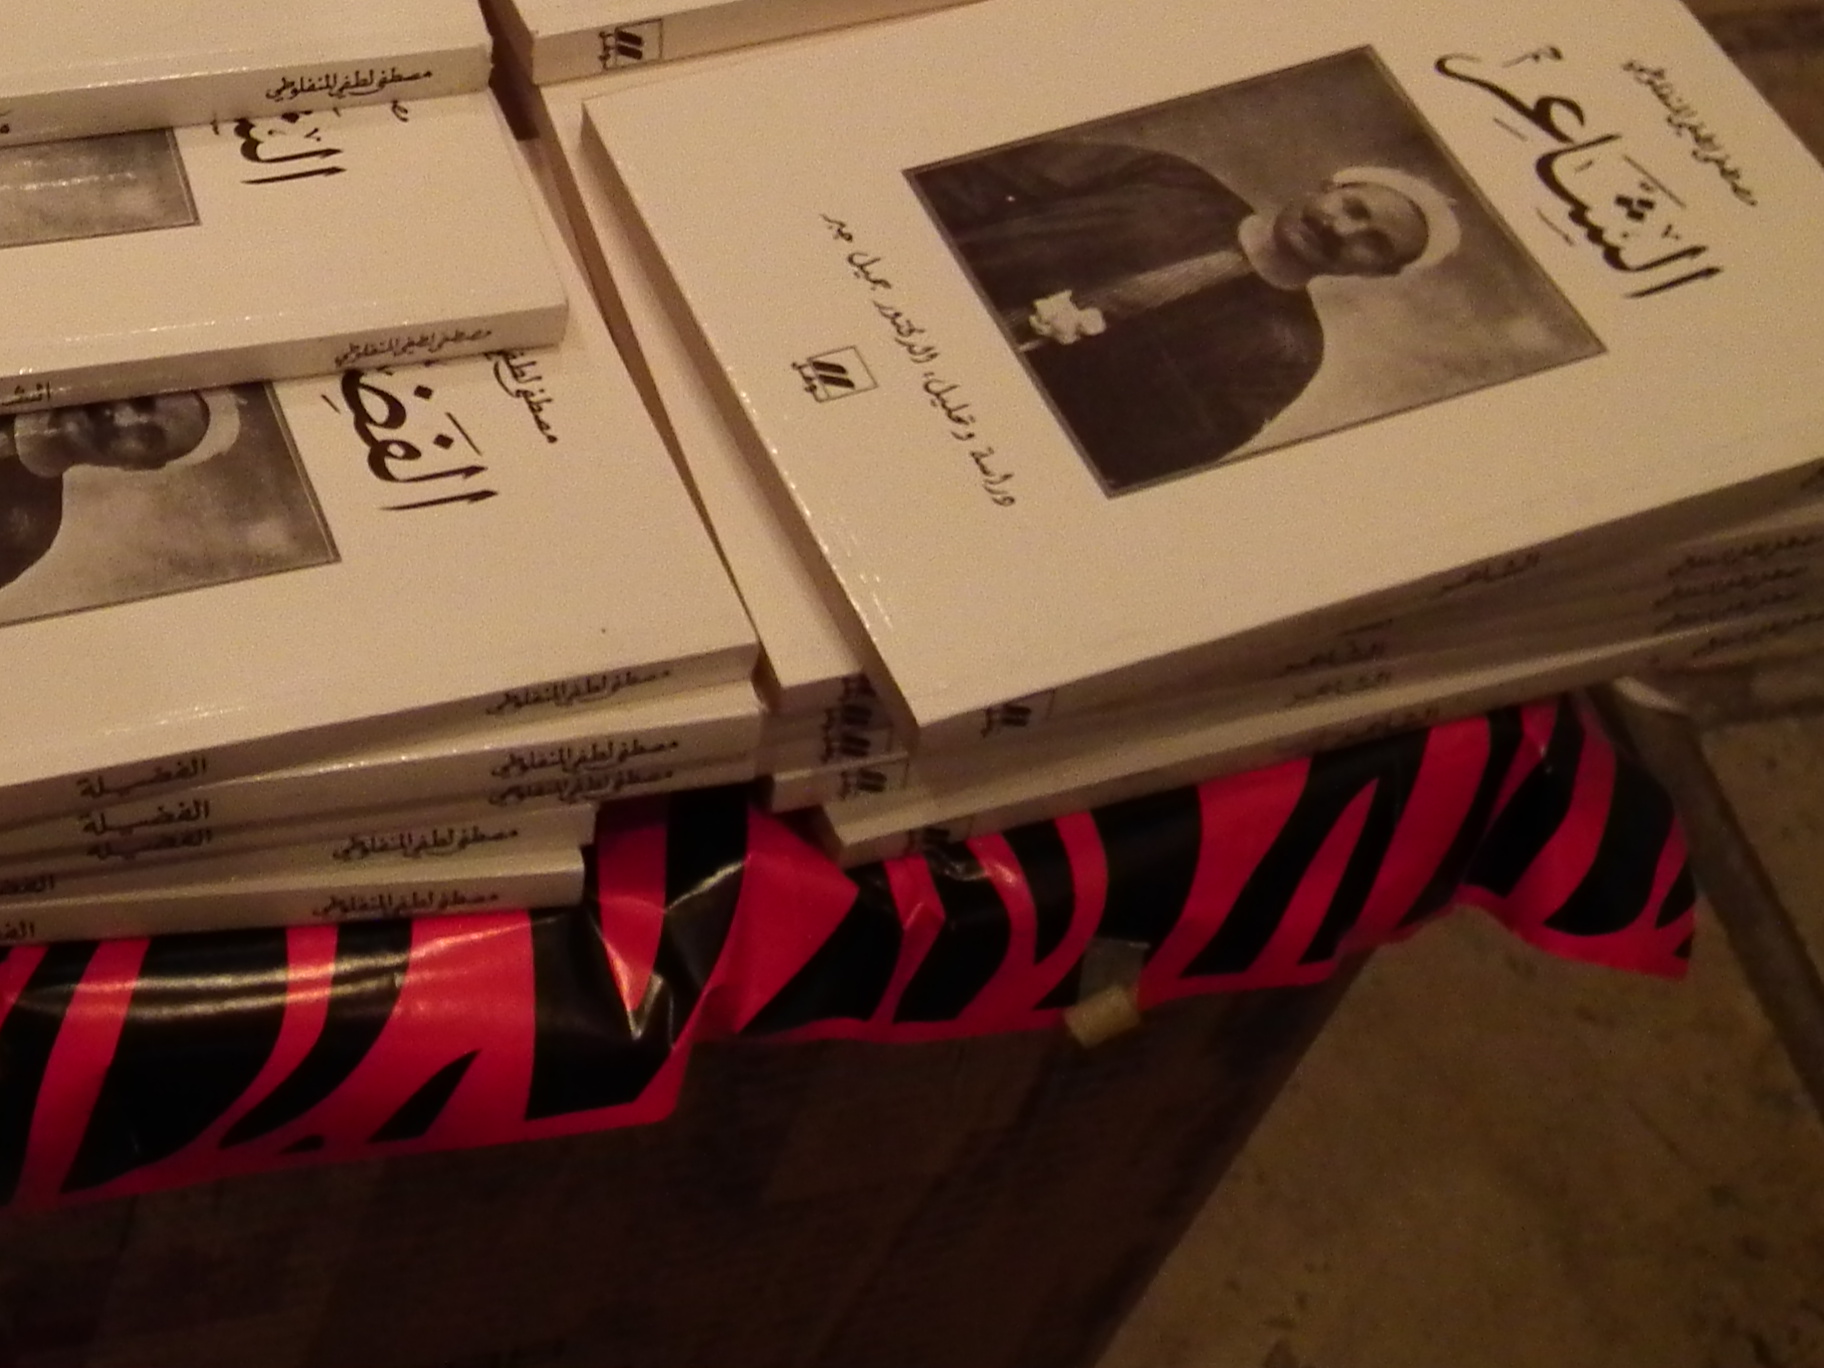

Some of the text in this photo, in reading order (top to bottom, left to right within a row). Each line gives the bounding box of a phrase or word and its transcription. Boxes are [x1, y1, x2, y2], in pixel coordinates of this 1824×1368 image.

[265, 72, 339, 103] المنفلوطي
[351, 67, 434, 95] مصطفى
[1433, 44, 1727, 301] الشاعر
[845, 251, 893, 293] جميل
[871, 300, 942, 364] الدكتور
[493, 359, 560, 446] مصطفى
[320, 358, 501, 512] الفض
[970, 448, 1019, 507] دراسة
[75, 756, 208, 800] الفضيلة
[79, 798, 211, 837] الفضيلة
